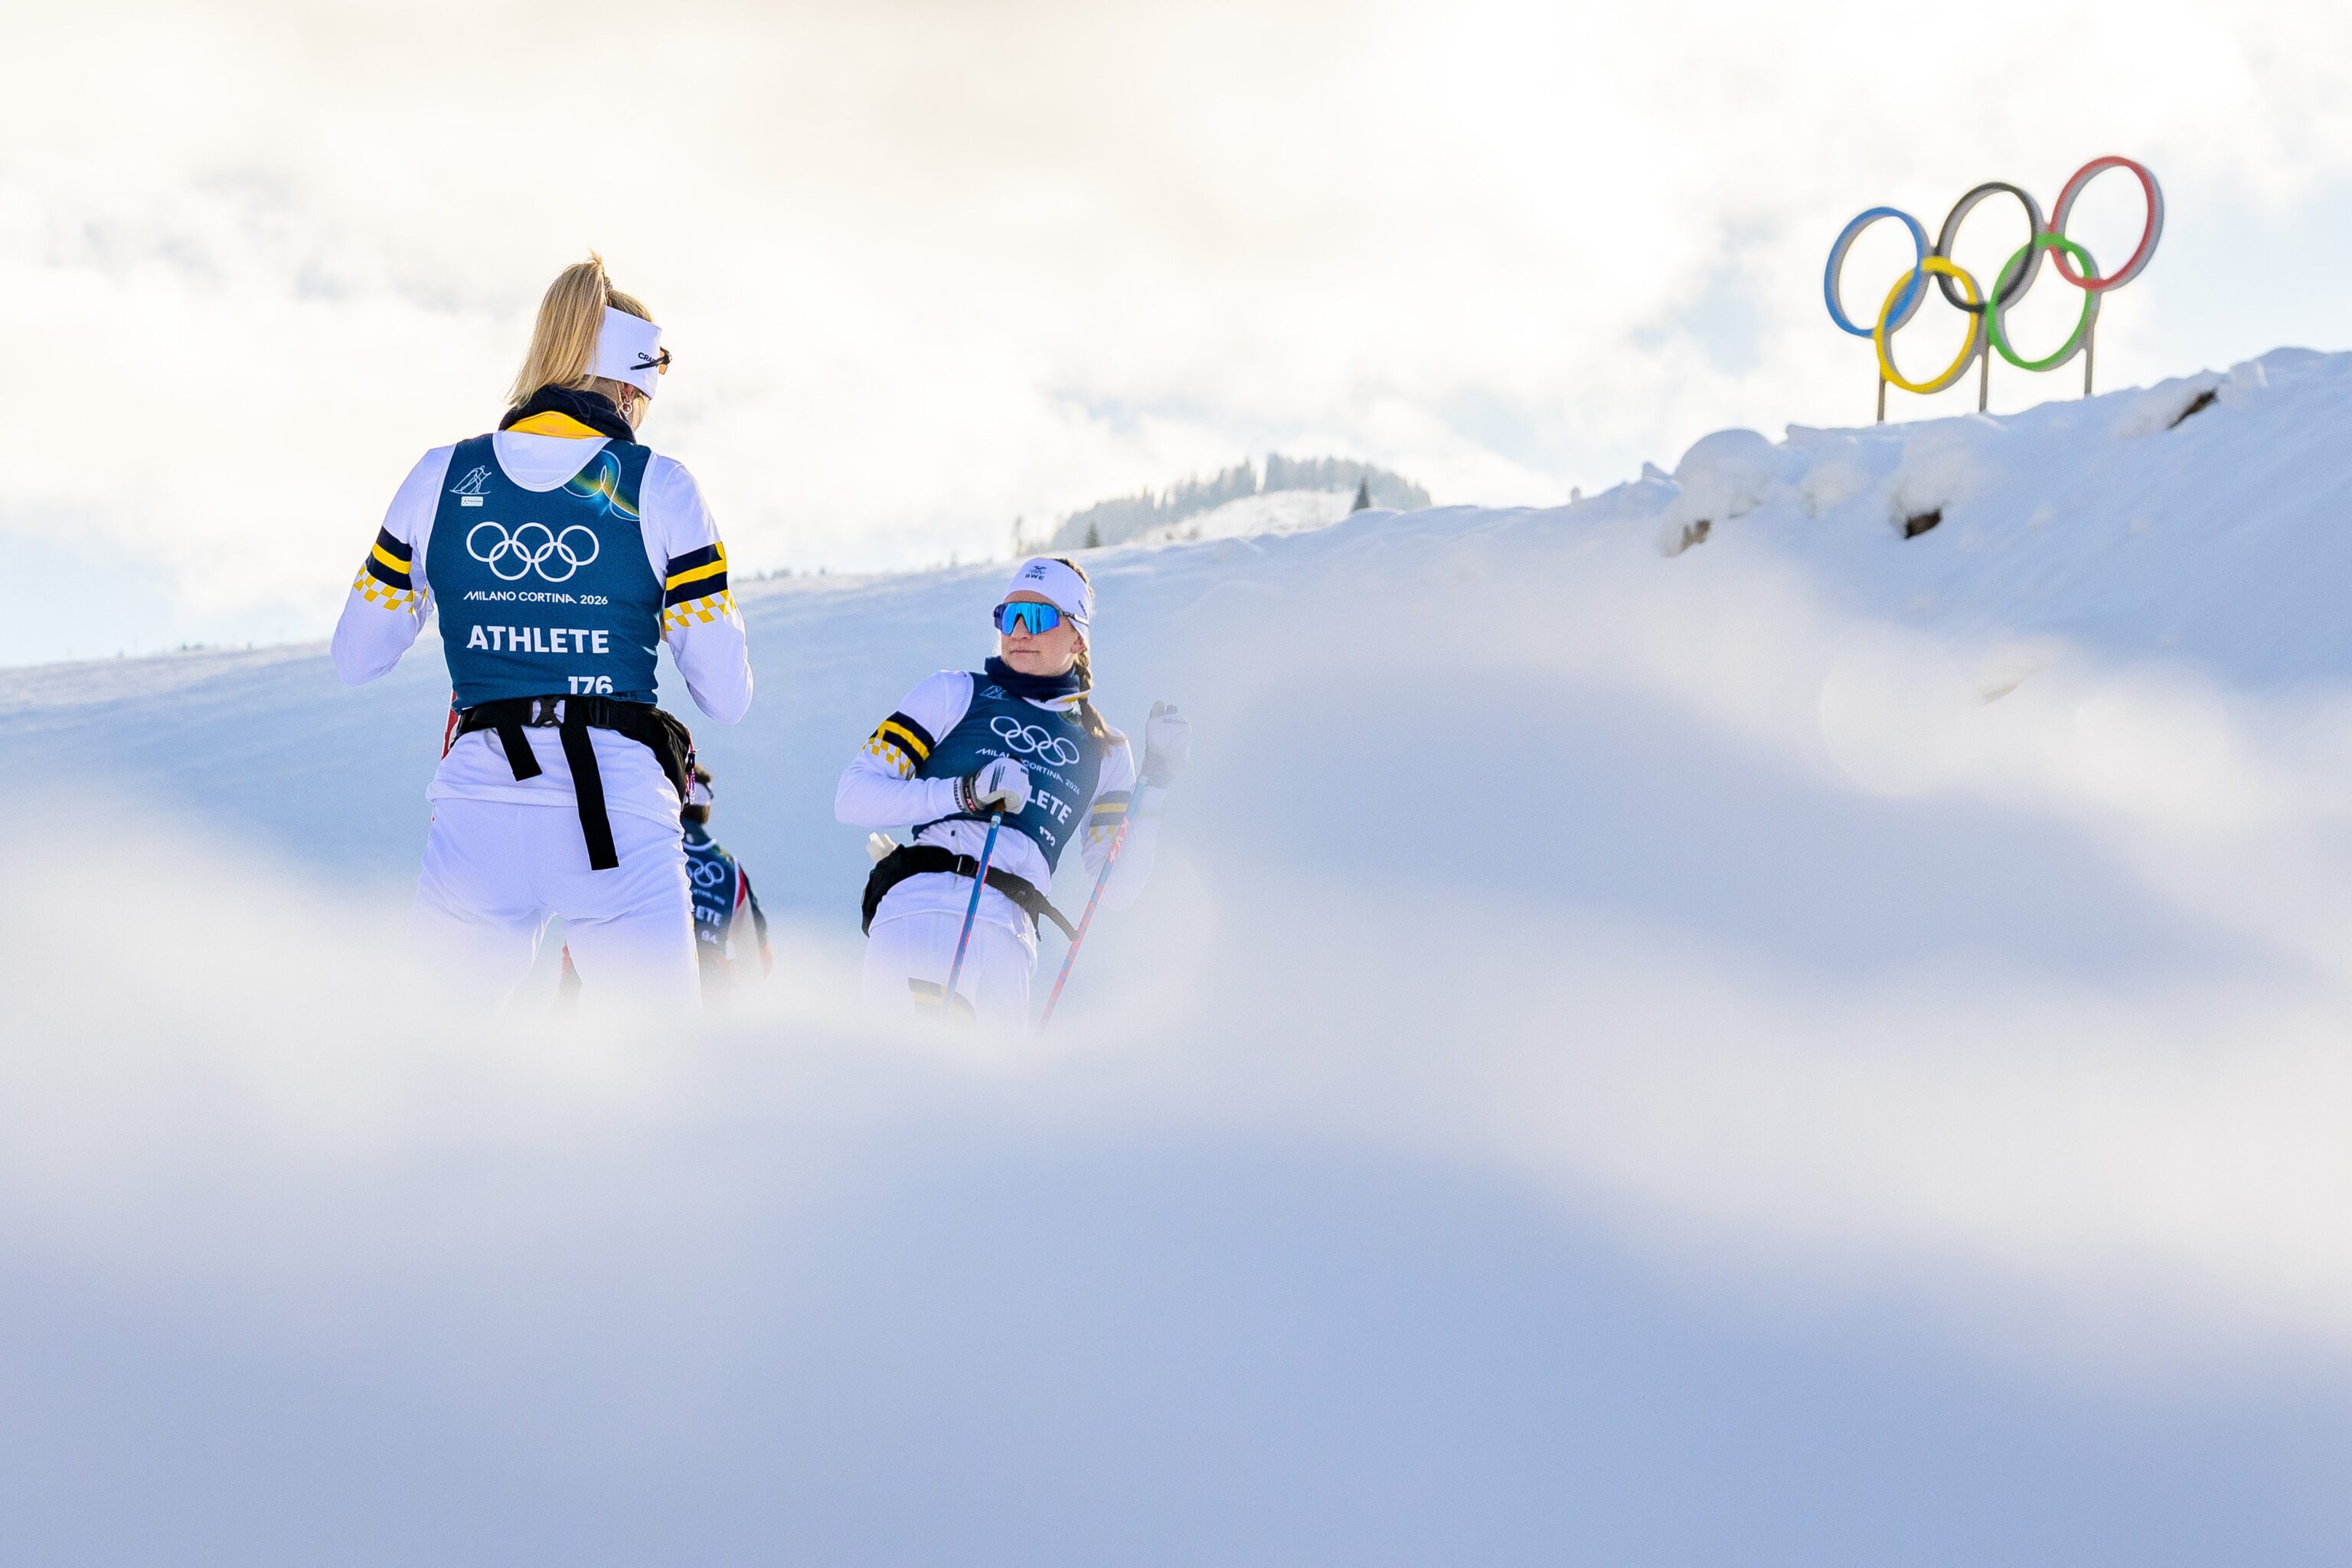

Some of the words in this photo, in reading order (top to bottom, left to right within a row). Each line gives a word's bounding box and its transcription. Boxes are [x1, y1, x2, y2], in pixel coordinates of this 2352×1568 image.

[638, 351, 657, 362] CRA
[463, 591, 516, 601] MILANO
[518, 592, 577, 604] CORTINA
[580, 595, 609, 605] 2026
[466, 625, 609, 654] ATHLETE
[567, 676, 613, 694] 176
[975, 748, 1010, 759] MILA
[1022, 760, 1063, 783] CORTINA
[1026, 786, 1073, 825] LETE
